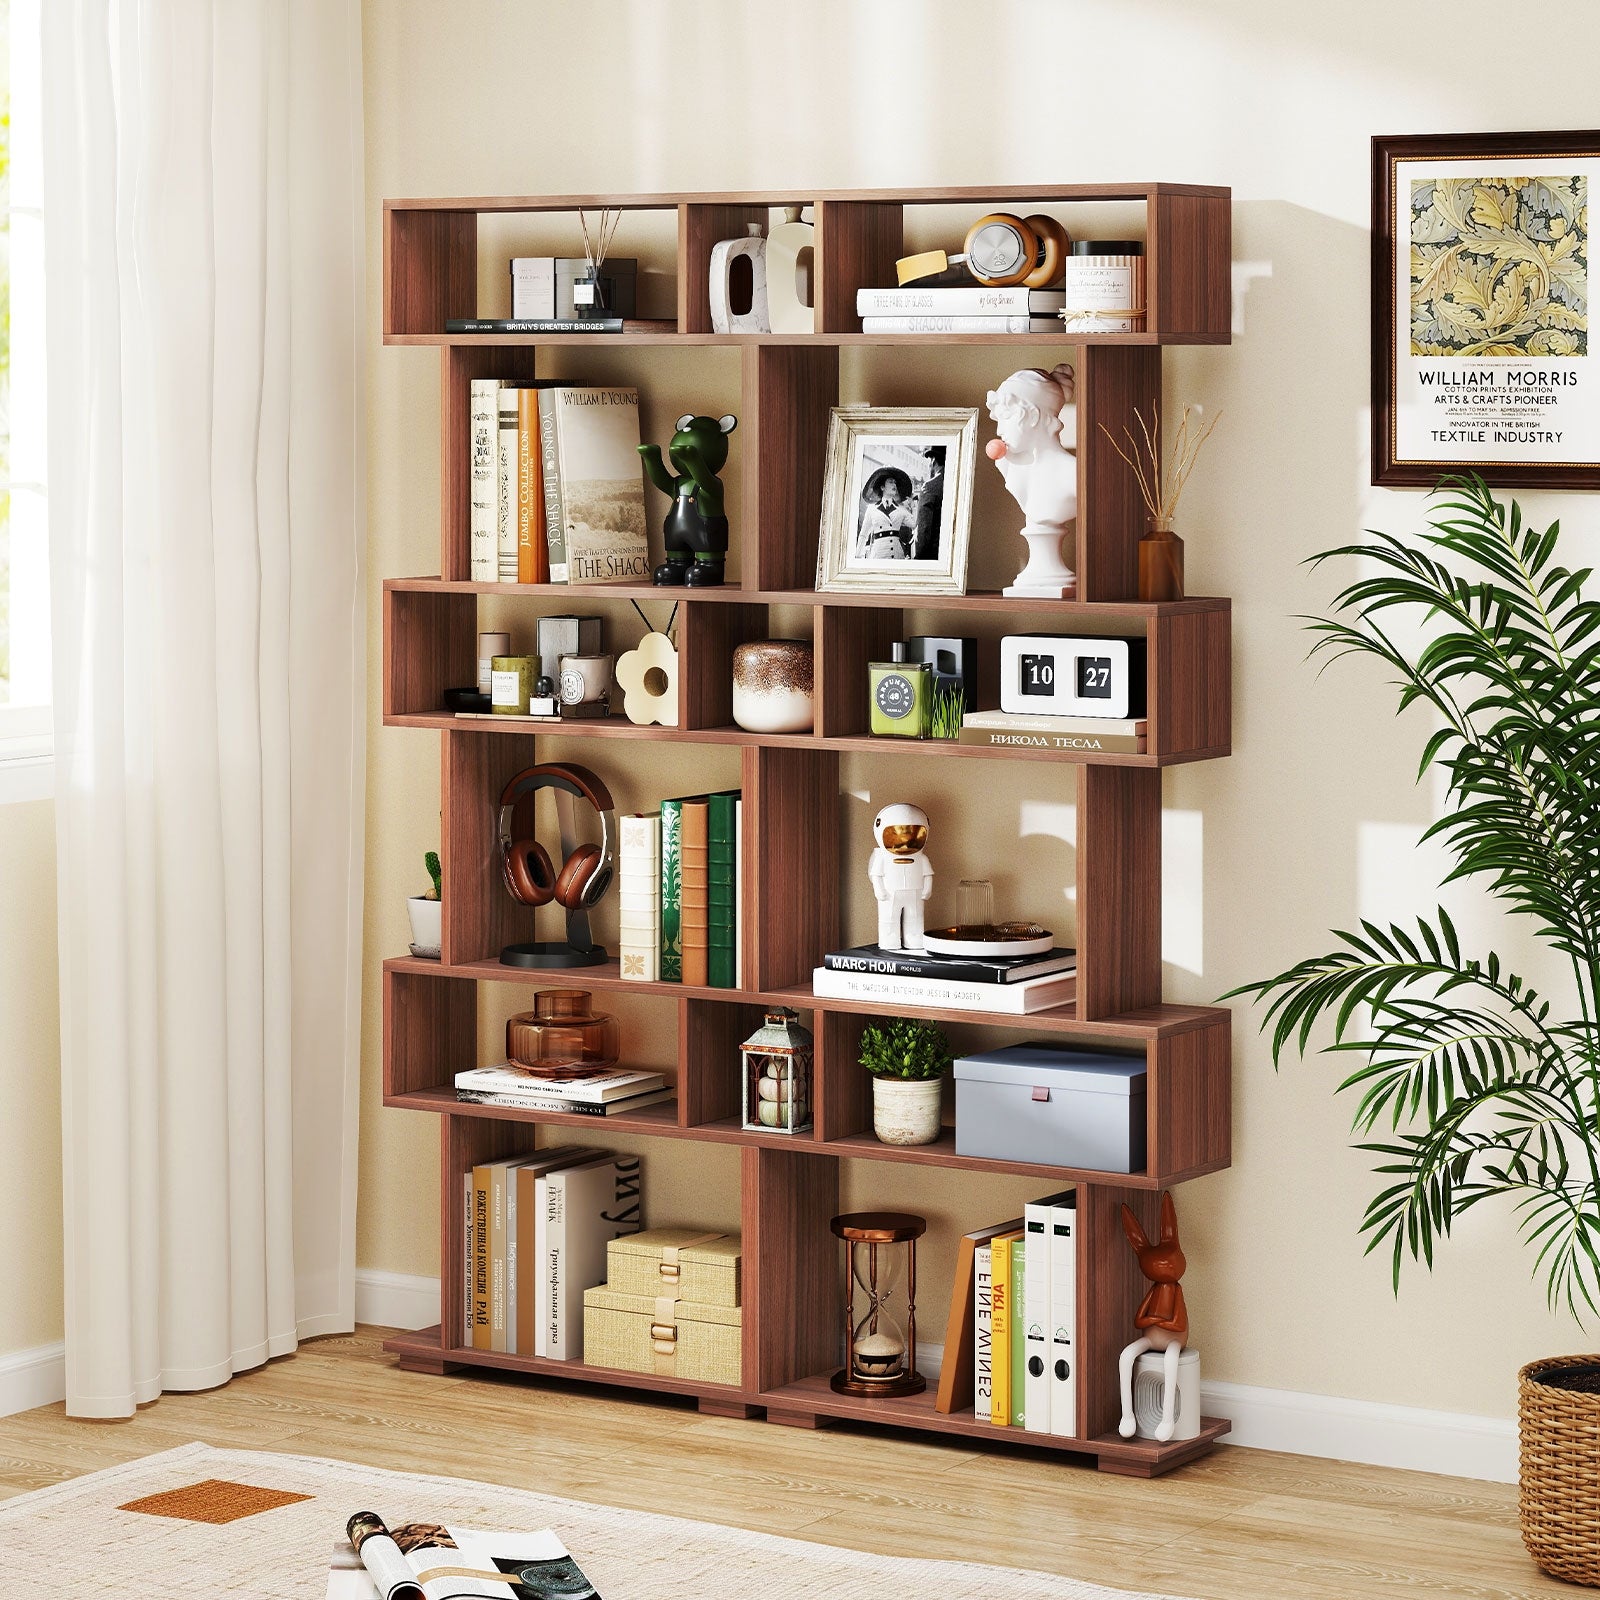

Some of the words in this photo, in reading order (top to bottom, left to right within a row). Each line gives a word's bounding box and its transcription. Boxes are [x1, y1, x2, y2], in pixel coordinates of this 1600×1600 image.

[506, 323, 538, 331] BRITAIN'S
[539, 323, 573, 331] GREATEST
[574, 323, 604, 331] BRIDGES
[908, 317, 953, 331] SHADOW
[1419, 371, 1494, 386] WILLIAM
[1507, 371, 1578, 386] MORRIS
[563, 391, 600, 406] WILLIAM
[608, 391, 639, 406] YOUNG
[1434, 395, 1460, 405] ARTS
[1462, 395, 1469, 405] &
[1472, 395, 1512, 405] CRAFTS
[1514, 395, 1558, 405] PIONEER
[542, 411, 555, 459] YOUNG
[1431, 430, 1486, 442] TEXTILE
[1494, 431, 1563, 443] INDUSTRY
[520, 430, 529, 504] COLLECTION
[545, 473, 558, 500] THE
[520, 507, 532, 548] JUMBO
[547, 503, 562, 547] SHACK
[574, 557, 602, 579] THE
[606, 555, 651, 577] SHACK
[1030, 664, 1053, 685] 10
[1085, 667, 1110, 687] 27
[889, 692, 900, 700] 48
[990, 734, 1049, 747] НИКОЛА
[1053, 737, 1102, 749] ТЕСЛА
[831, 957, 867, 971] MARC
[868, 960, 897, 974] HOM
[848, 981, 859, 991] THE
[862, 983, 889, 993] SWEDISH
[893, 985, 923, 996] INTERIOR
[926, 988, 950, 998] DESIGN
[494, 1098, 559, 1110] MOCKINGBIRD
[569, 1105, 588, 1113] KILL
[548, 1186, 556, 1223] РЕМАРК
[477, 1189, 487, 1254] БОЖЕСТВЕННАЯ
[466, 1224, 474, 1260] Уличный
[477, 1255, 487, 1294] КОМЕДИЯ
[507, 1242, 517, 1290] Избранное
[466, 1275, 472, 1287] по
[549, 1247, 560, 1319] Триумфальная
[476, 1300, 489, 1326] РАЙ
[549, 1322, 558, 1344] арка
